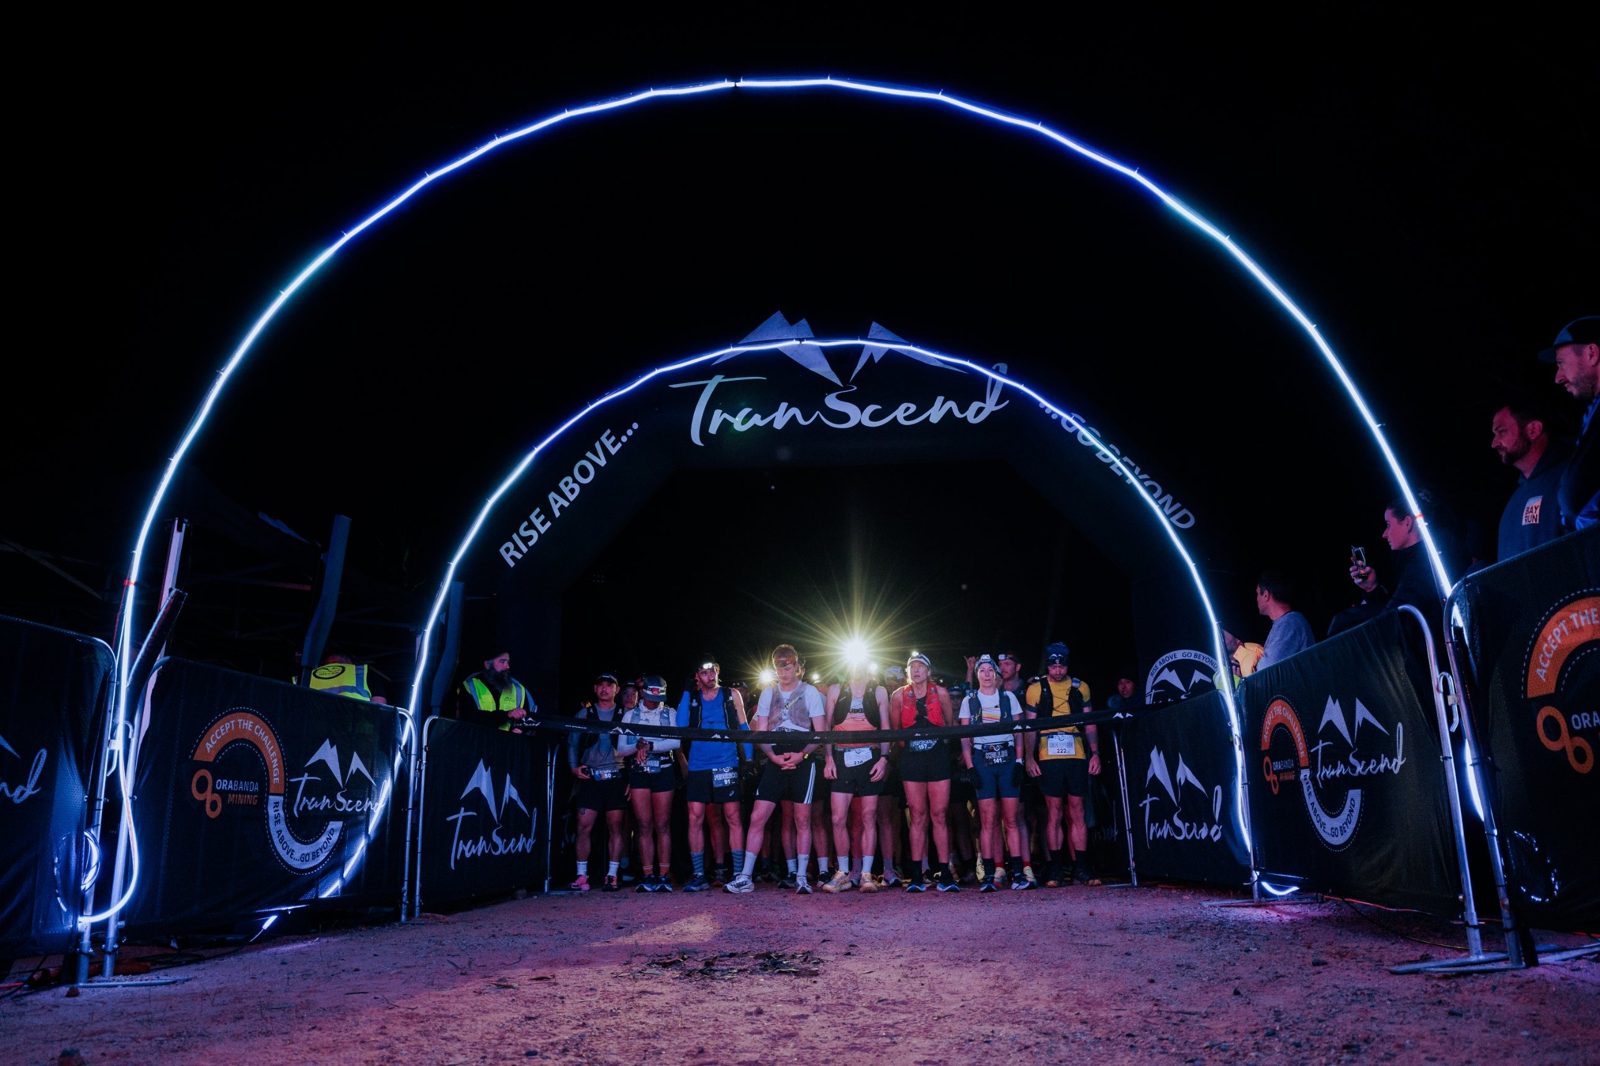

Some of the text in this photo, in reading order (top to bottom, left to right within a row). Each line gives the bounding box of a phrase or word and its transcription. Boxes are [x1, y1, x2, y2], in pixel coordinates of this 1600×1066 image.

[668, 363, 1009, 446] TranScend
[499, 422, 639, 568] RISE ABOVE...
[1525, 505, 1539, 514] BAY
[1525, 514, 1538, 523] RUN
[1158, 653, 1179, 666] ABOVE
[1535, 608, 1600, 682] ACCEPT THE
[205, 719, 280, 785] ACCEPT THE CHALLENGE
[1310, 721, 1406, 789] TranScend
[216, 779, 259, 793] ORABANDA
[228, 794, 258, 806] MINING
[273, 801, 282, 827] RISE
[312, 828, 336, 861] BEYOND
